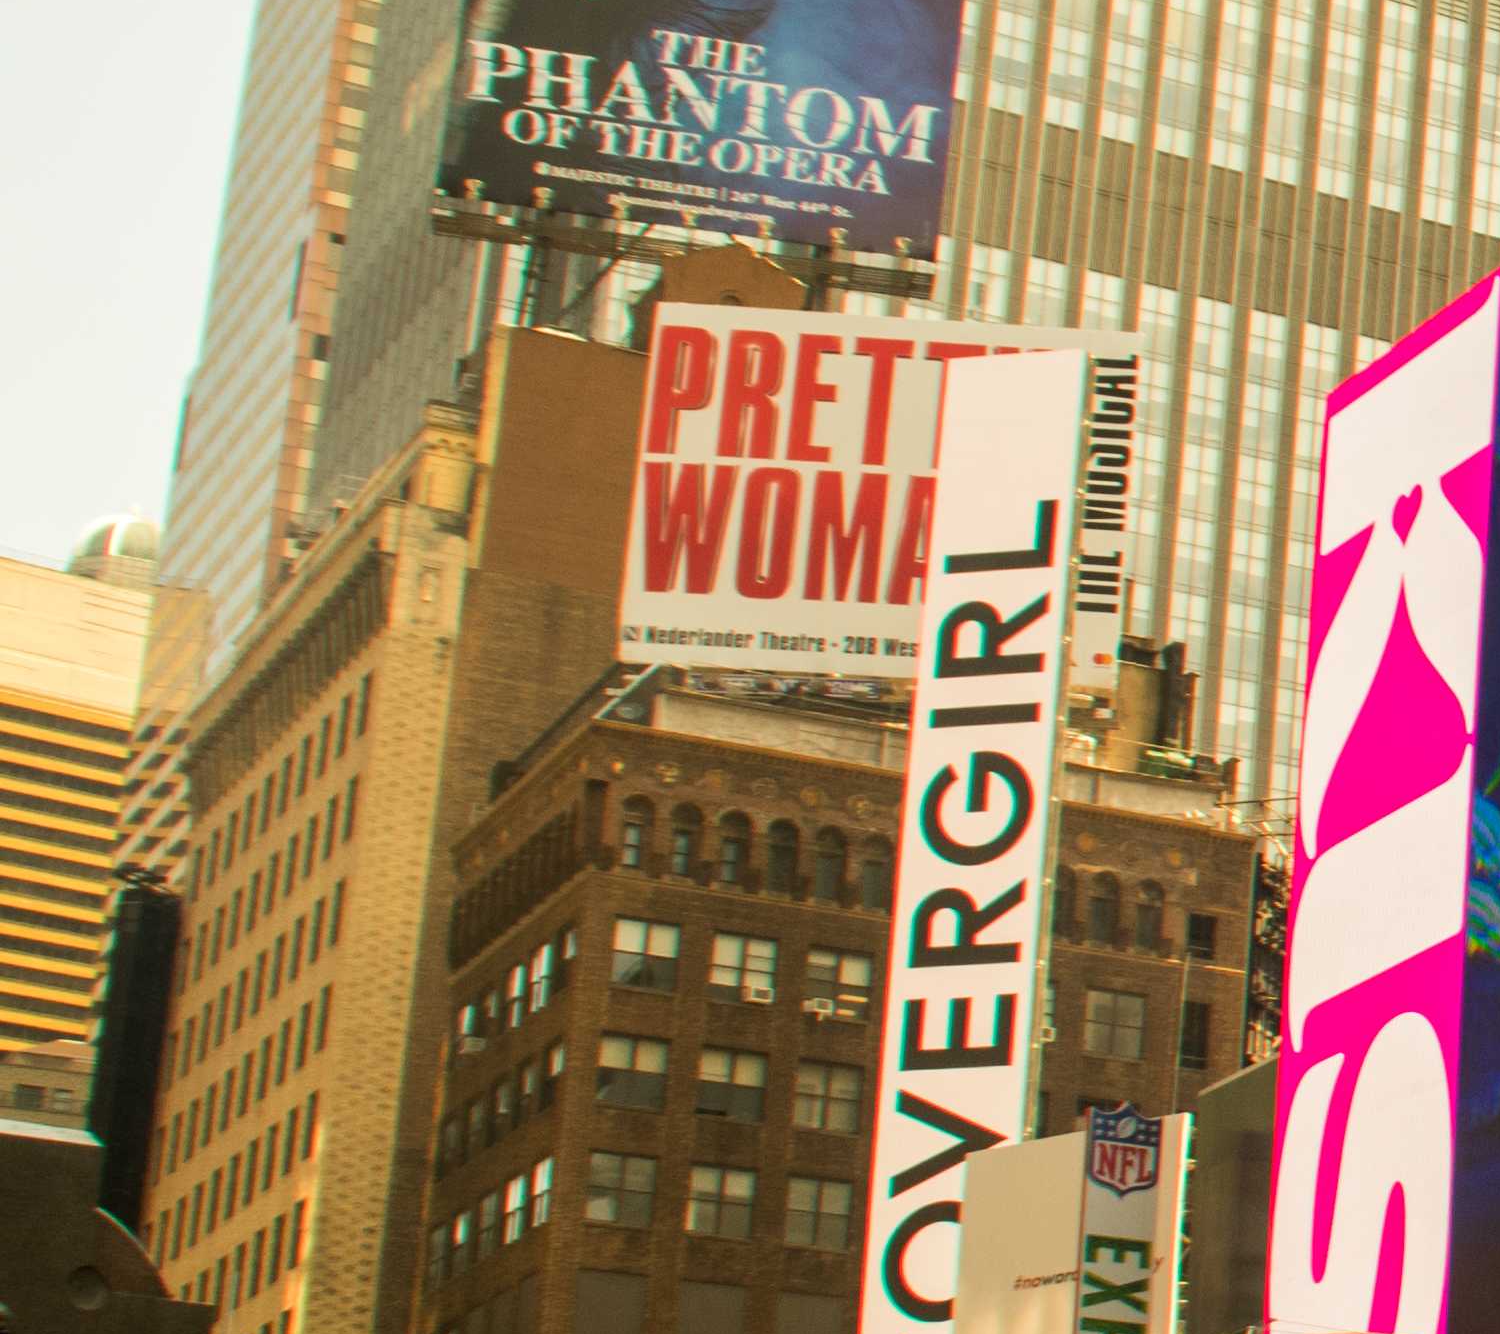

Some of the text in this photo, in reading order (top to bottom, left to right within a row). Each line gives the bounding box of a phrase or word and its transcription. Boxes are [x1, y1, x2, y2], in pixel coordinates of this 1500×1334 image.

[654, 29, 766, 77] THE
[464, 39, 941, 164] PHANTOM
[503, 108, 890, 196] OF THE OPERA
[550, 164, 633, 187] MAJESTIC
[646, 324, 1052, 466] PRET
[643, 461, 939, 605] WOMA
[645, 625, 754, 650] Nederlander
[760, 630, 826, 654] Theatre
[883, 637, 919, 658] Wes
[1094, 1139, 1154, 1189] NFL
